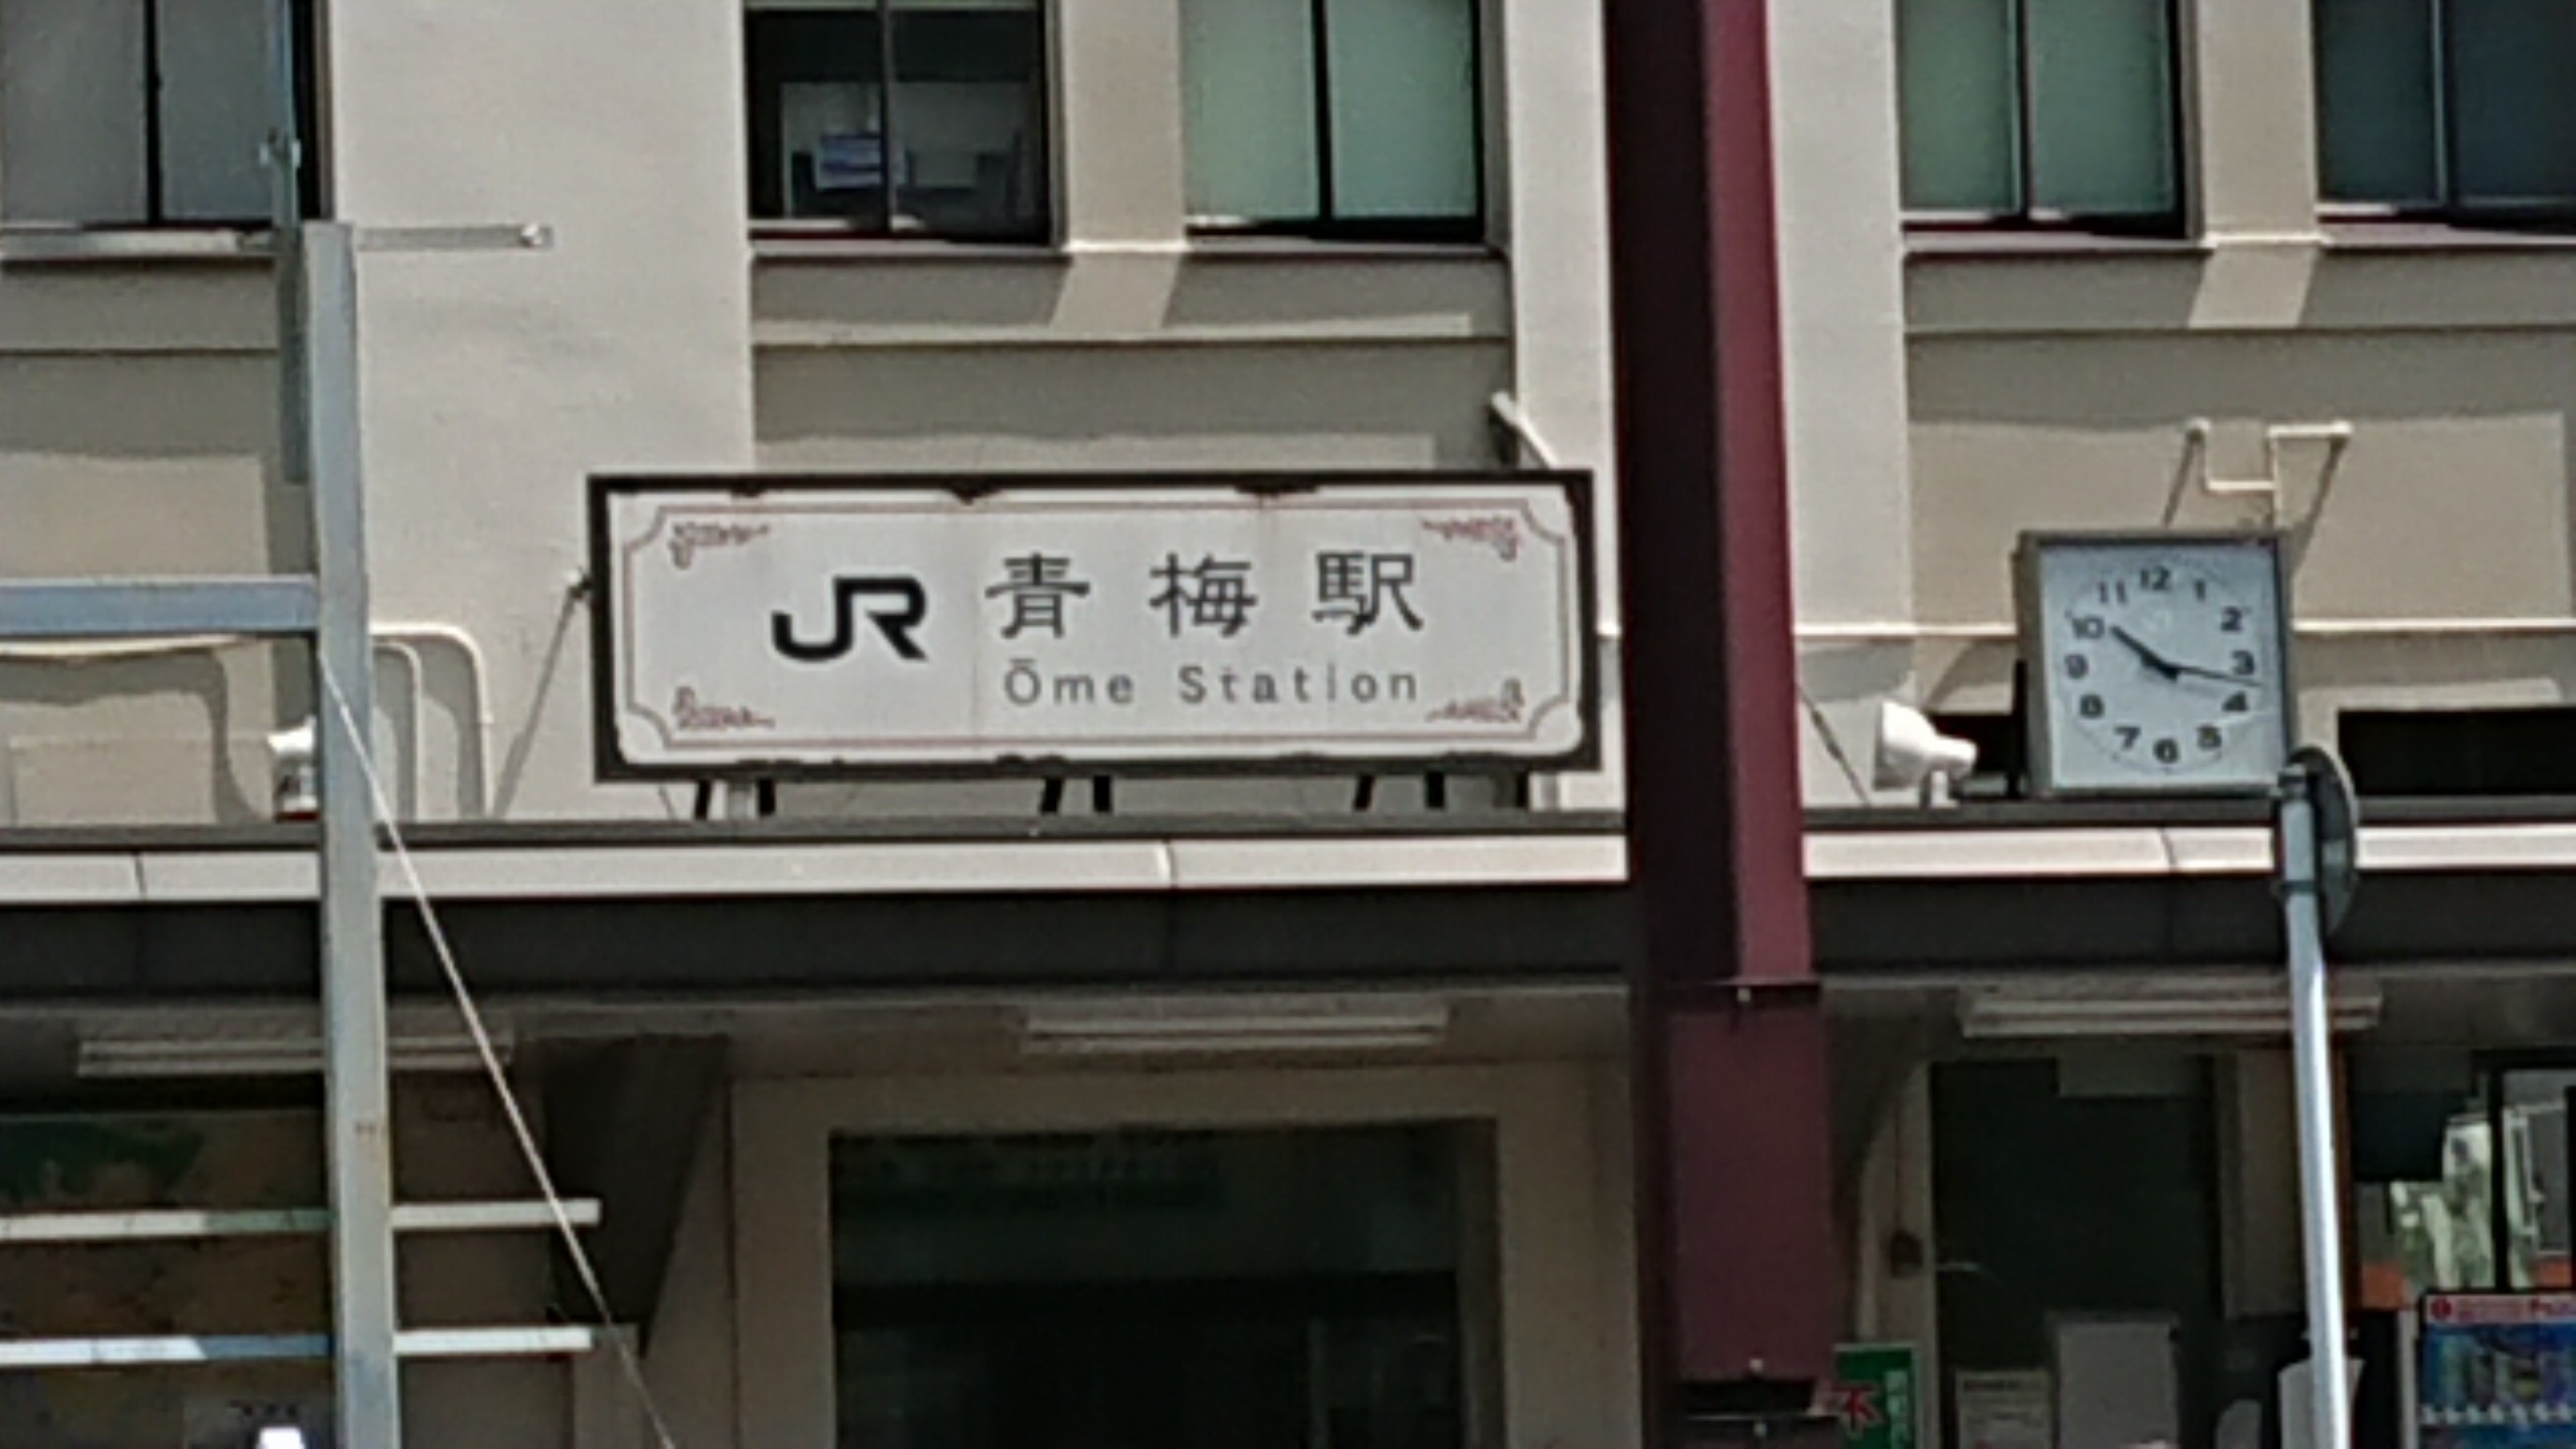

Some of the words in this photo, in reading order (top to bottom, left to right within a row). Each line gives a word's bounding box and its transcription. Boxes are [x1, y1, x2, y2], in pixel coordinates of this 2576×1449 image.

[2141, 567, 2172, 591] 12
[770, 575, 928, 663] JR
[986, 551, 1425, 638] 青梅駅
[2221, 607, 2243, 632] 2
[2072, 616, 2104, 639] 10
[2065, 653, 2088, 680] 9
[2232, 650, 2255, 675] 3
[1179, 664, 1416, 704] Station
[2221, 692, 2249, 712] 4
[2115, 725, 2141, 748] 7
[2197, 725, 2221, 750] 5
[2153, 738, 2179, 764] 6
